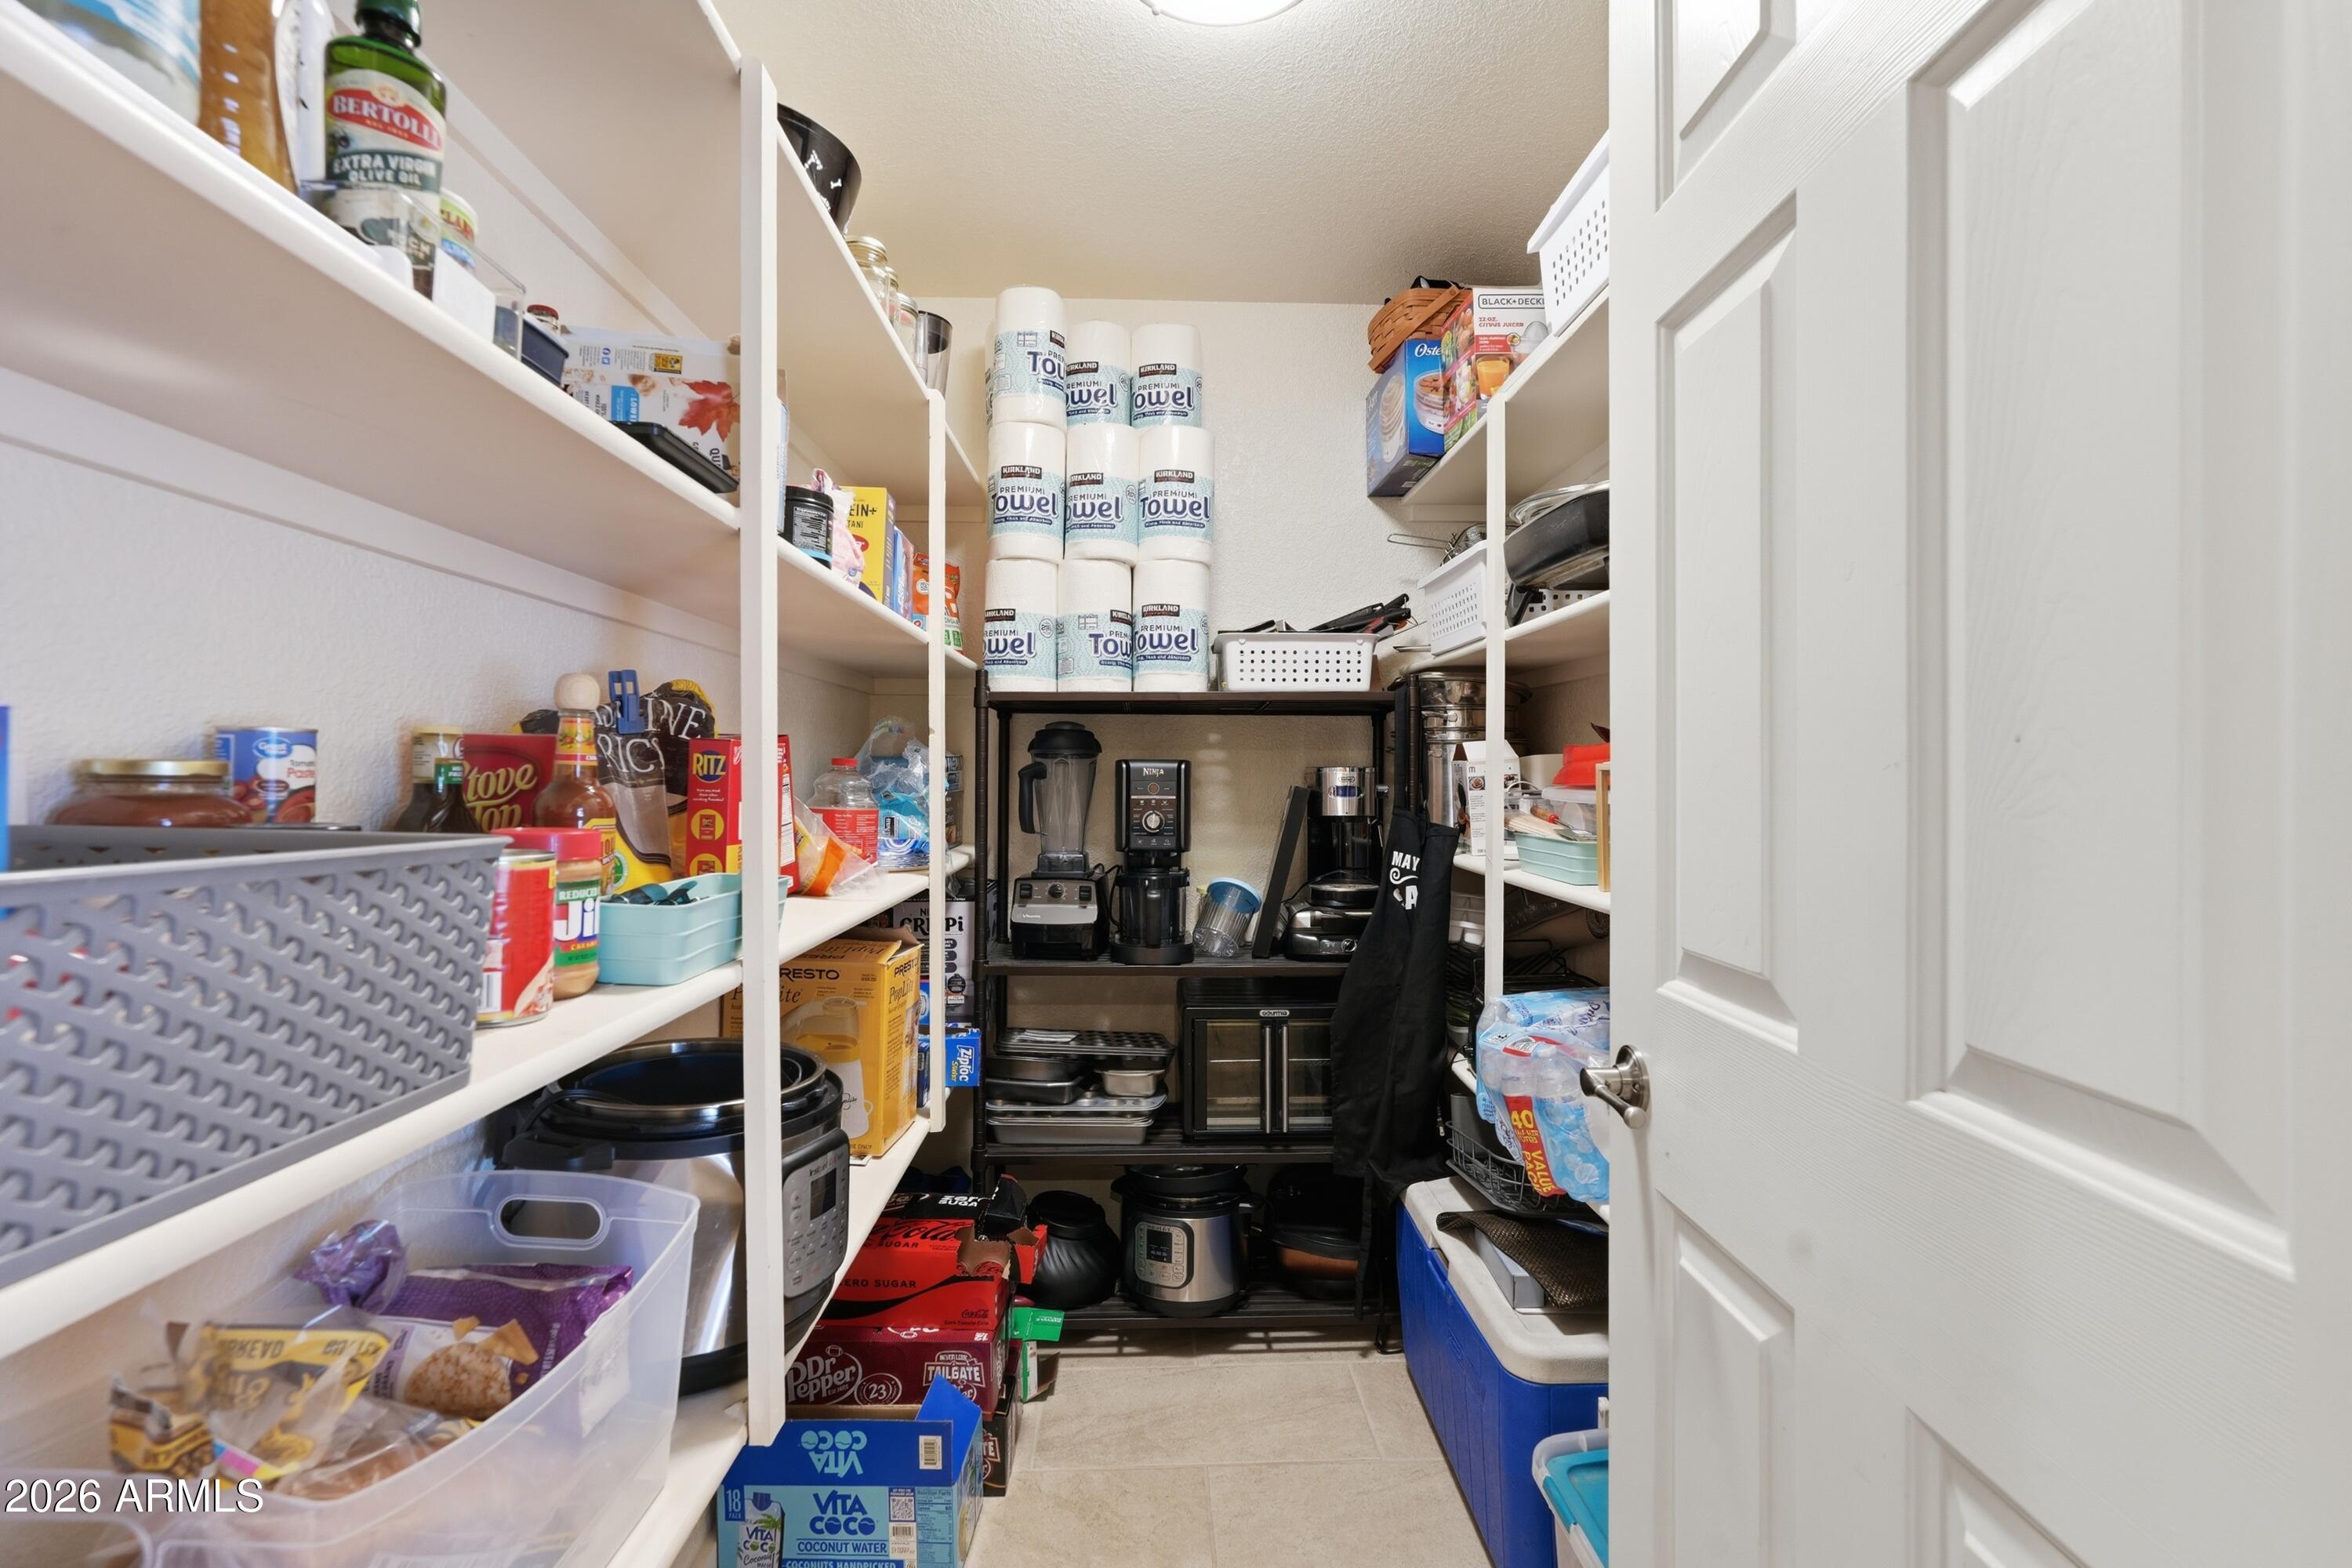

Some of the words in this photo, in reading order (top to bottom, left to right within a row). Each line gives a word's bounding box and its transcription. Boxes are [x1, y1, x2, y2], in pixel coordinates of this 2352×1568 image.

[332, 94, 441, 147] BERTOLLI
[332, 154, 384, 174] EXTRA
[348, 168, 394, 183] OLIVE
[397, 171, 422, 187] OIL
[1139, 364, 1176, 373] KIRKLAND
[1138, 383, 1178, 391] PREMIUM
[1132, 386, 1193, 409] owel
[1003, 466, 1041, 474] KIRKLAND
[1000, 485, 1044, 495] PREMIUM
[1152, 489, 1195, 498] PREMIUM
[1139, 496, 1210, 519] Towel
[692, 753, 726, 776] RITZ
[1142, 767, 1165, 778] NINJA
[1391, 851, 1421, 872] MAY
[959, 1047, 972, 1083] Ziploc
[1511, 1109, 1534, 1129] 40
[1531, 1149, 1556, 1192] VALUE
[874, 1279, 916, 1289] SUGAR
[806, 1356, 837, 1380] Dr
[786, 1361, 856, 1403] Pepper
[868, 1382, 887, 1399] 23
[800, 1430, 867, 1450] COCO
[809, 1450, 864, 1479] VITA
[726, 1489, 742, 1512] 18
[812, 1490, 868, 1515] VITA
[746, 1526, 774, 1542] VITA
[809, 1515, 877, 1536] COCO
[797, 1541, 854, 1553] COCONUT
[856, 1542, 887, 1554] WATER
